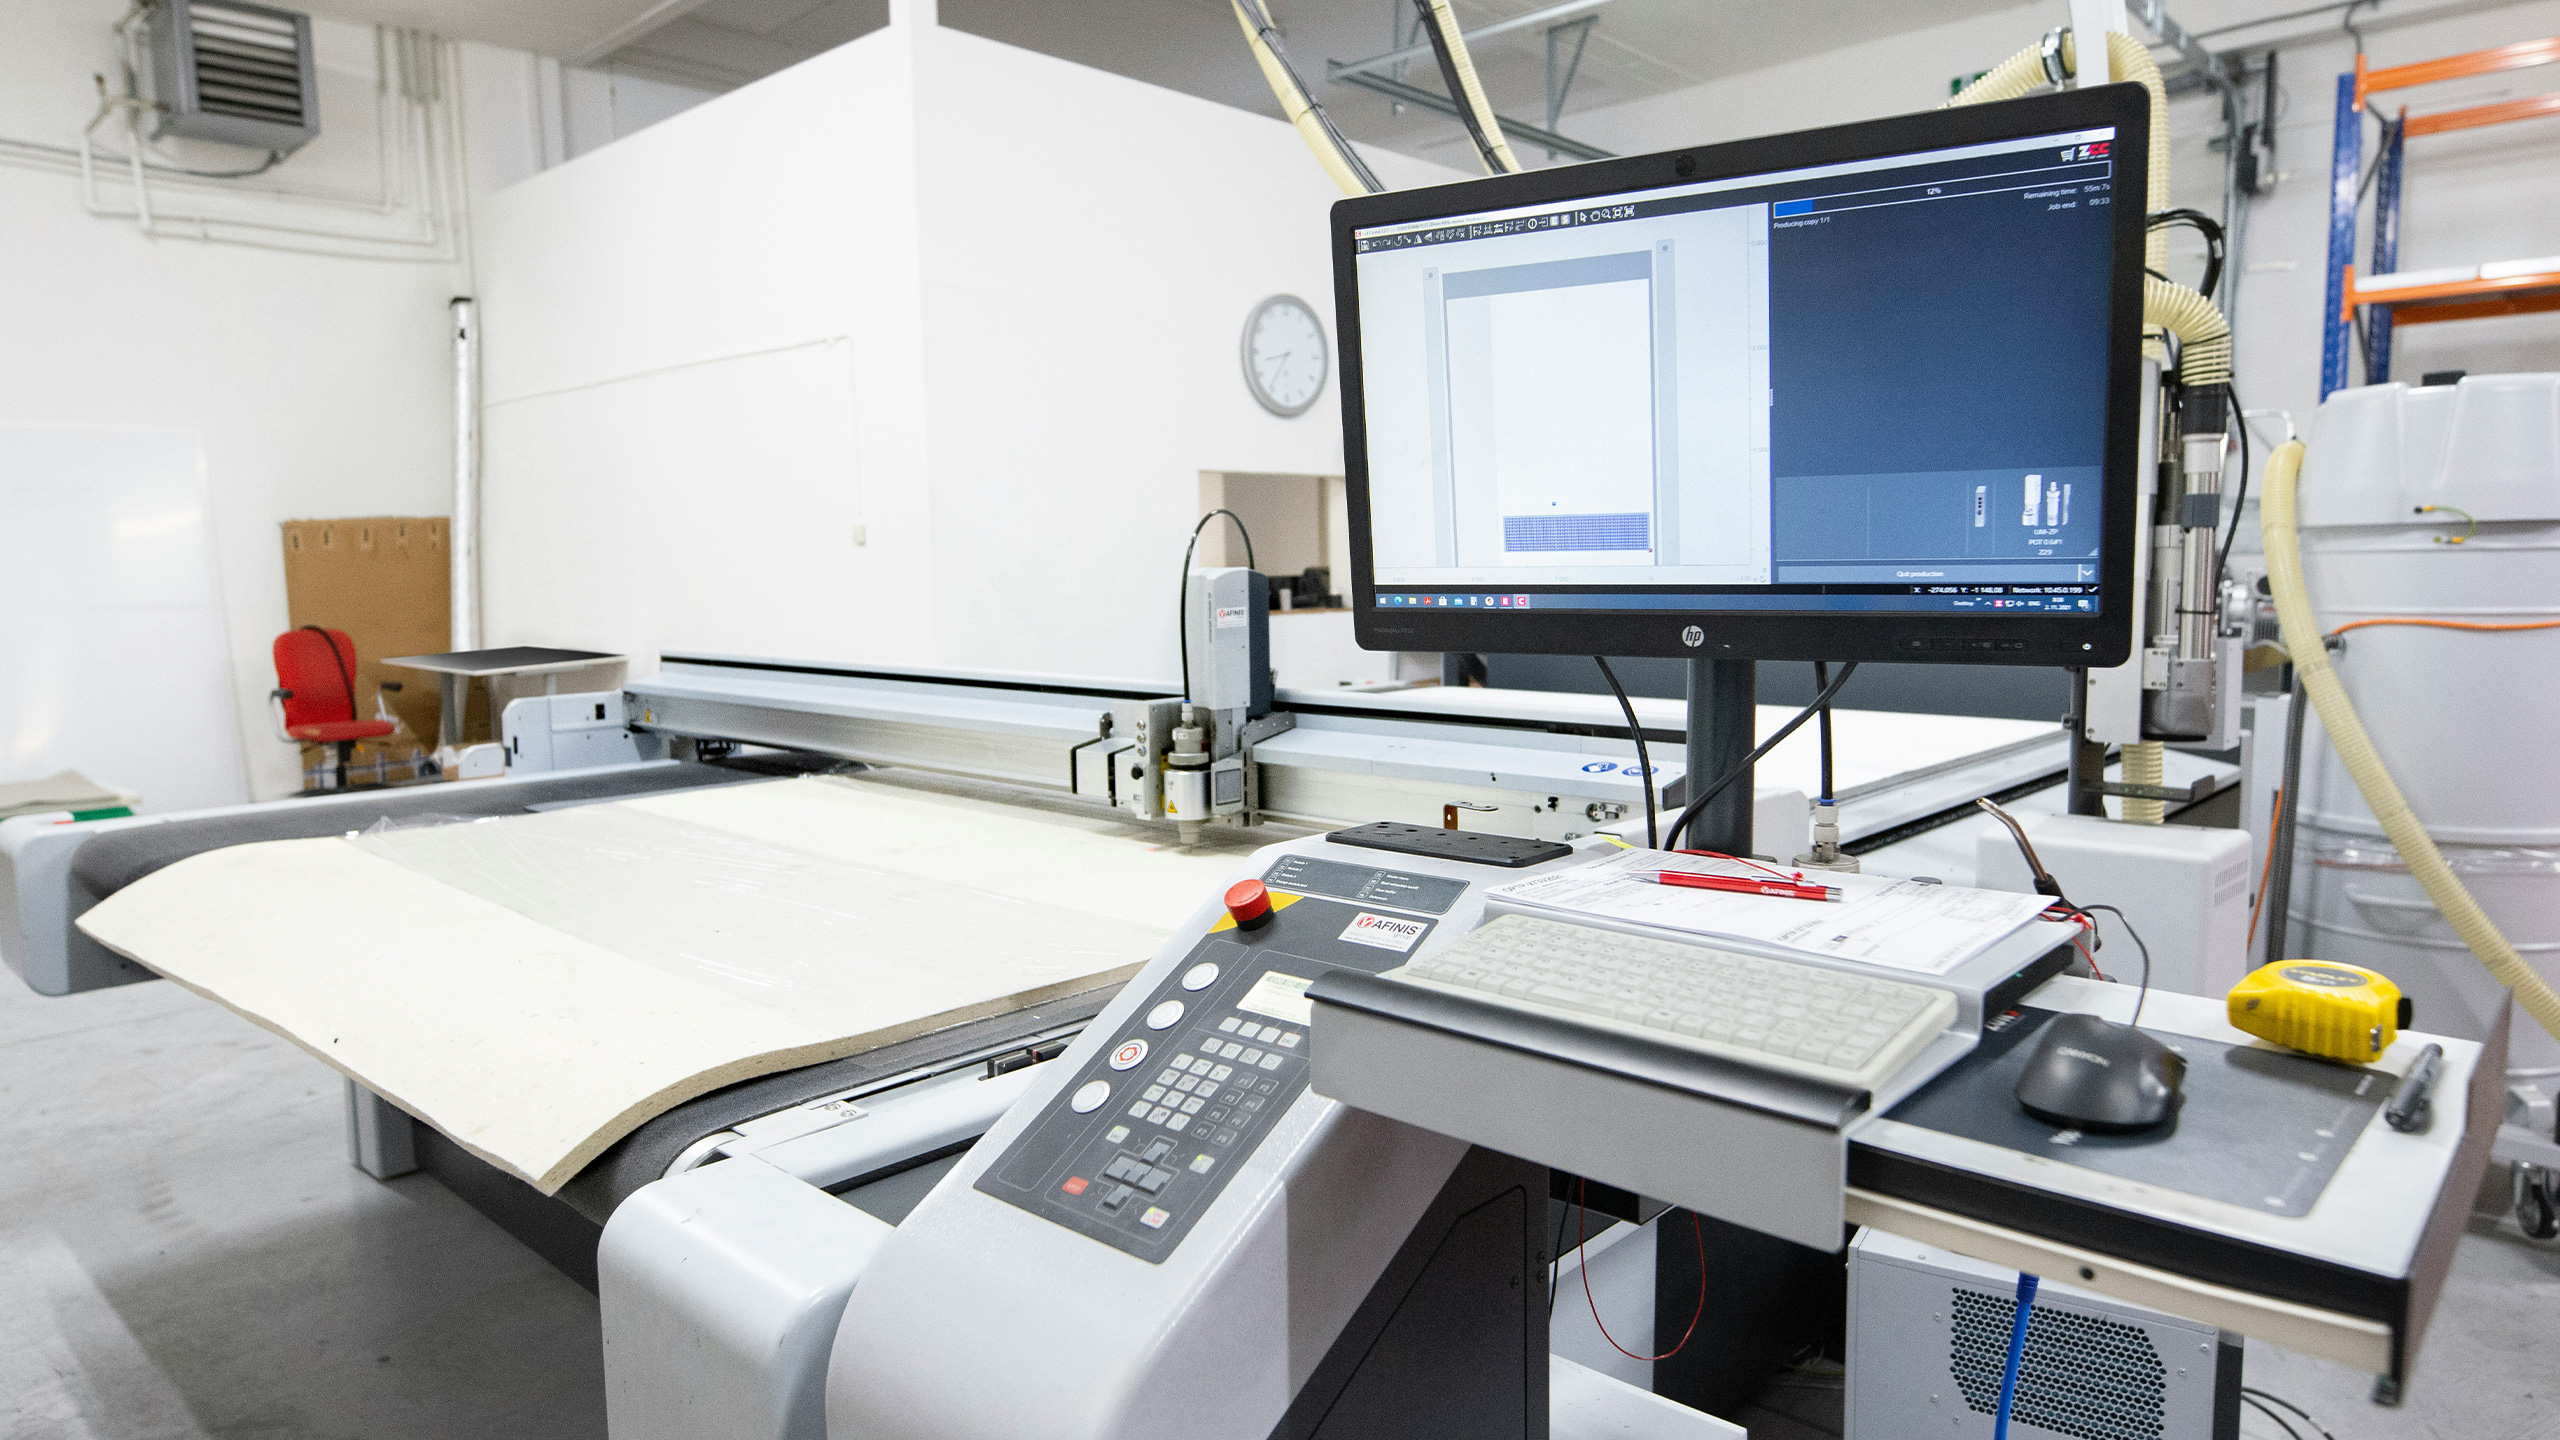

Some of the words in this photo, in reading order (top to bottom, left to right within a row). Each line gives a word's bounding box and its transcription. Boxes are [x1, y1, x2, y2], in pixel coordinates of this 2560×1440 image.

[2078, 142, 2110, 157] ZCC
[1926, 186, 1942, 195] 12%
[2023, 189, 2061, 200] Remaining
[2048, 203, 2061, 211] Job
[1773, 220, 1804, 229] Producing
[1804, 218, 1819, 227] copy
[1820, 216, 1830, 224] 1/1
[1683, 625, 1703, 647] hp
[1371, 920, 1419, 935] AFINIS
